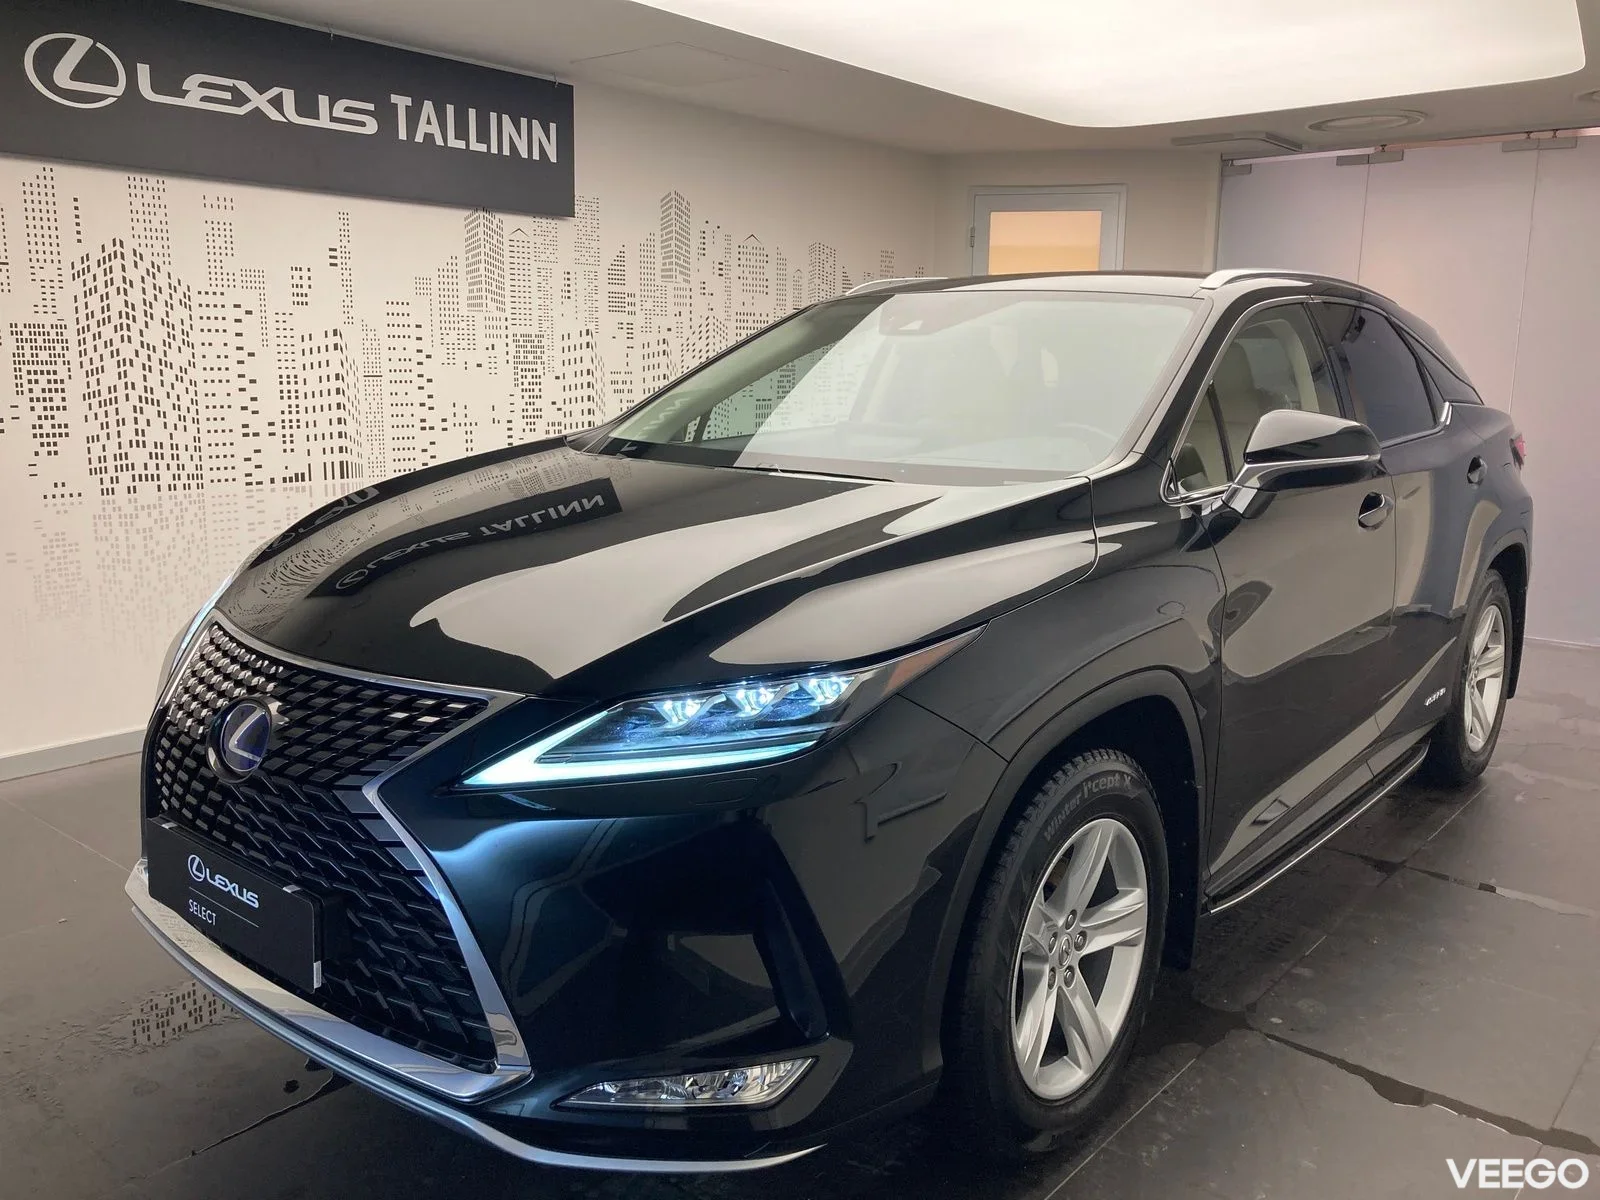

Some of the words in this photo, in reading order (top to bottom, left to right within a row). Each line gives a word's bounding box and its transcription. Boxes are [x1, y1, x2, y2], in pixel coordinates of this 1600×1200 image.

[136, 62, 378, 135] LEXUS
[390, 94, 558, 163] TALLINN
[206, 868, 259, 908] LEXUS
[189, 899, 216, 925] SELECT
